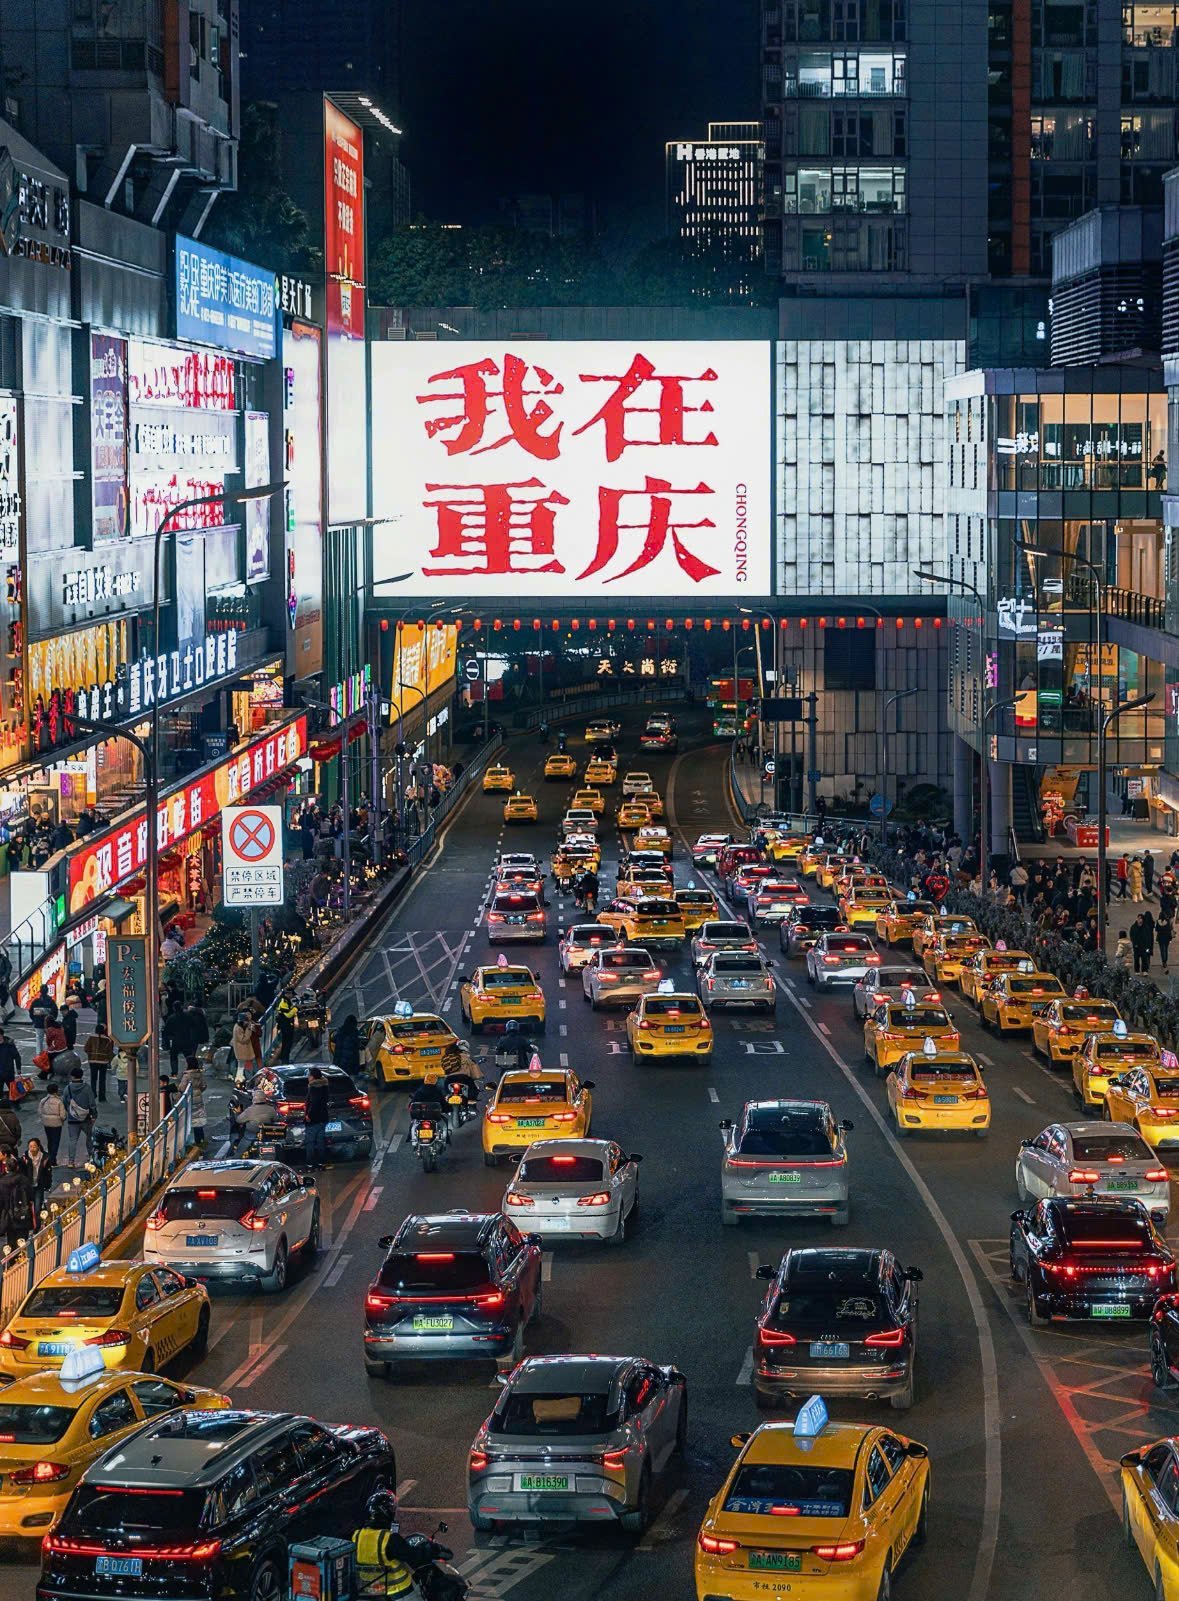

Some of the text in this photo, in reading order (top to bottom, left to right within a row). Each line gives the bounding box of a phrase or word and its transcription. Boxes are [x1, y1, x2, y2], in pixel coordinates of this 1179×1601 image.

[416, 353, 719, 463] 我在
[421, 476, 721, 584] 重庆
[735, 483, 748, 582] CHONGQING
[130, 628, 237, 713] 重庆牙卫士口腔医院
[228, 723, 297, 801] 观音桥好吃街
[96, 787, 202, 890] 观音桥好吃街
[231, 870, 277, 882] 禁停区域
[232, 887, 277, 899] 严禁停车
[116, 945, 131, 962] P
[773, 1583, 792, 1591] 2090
